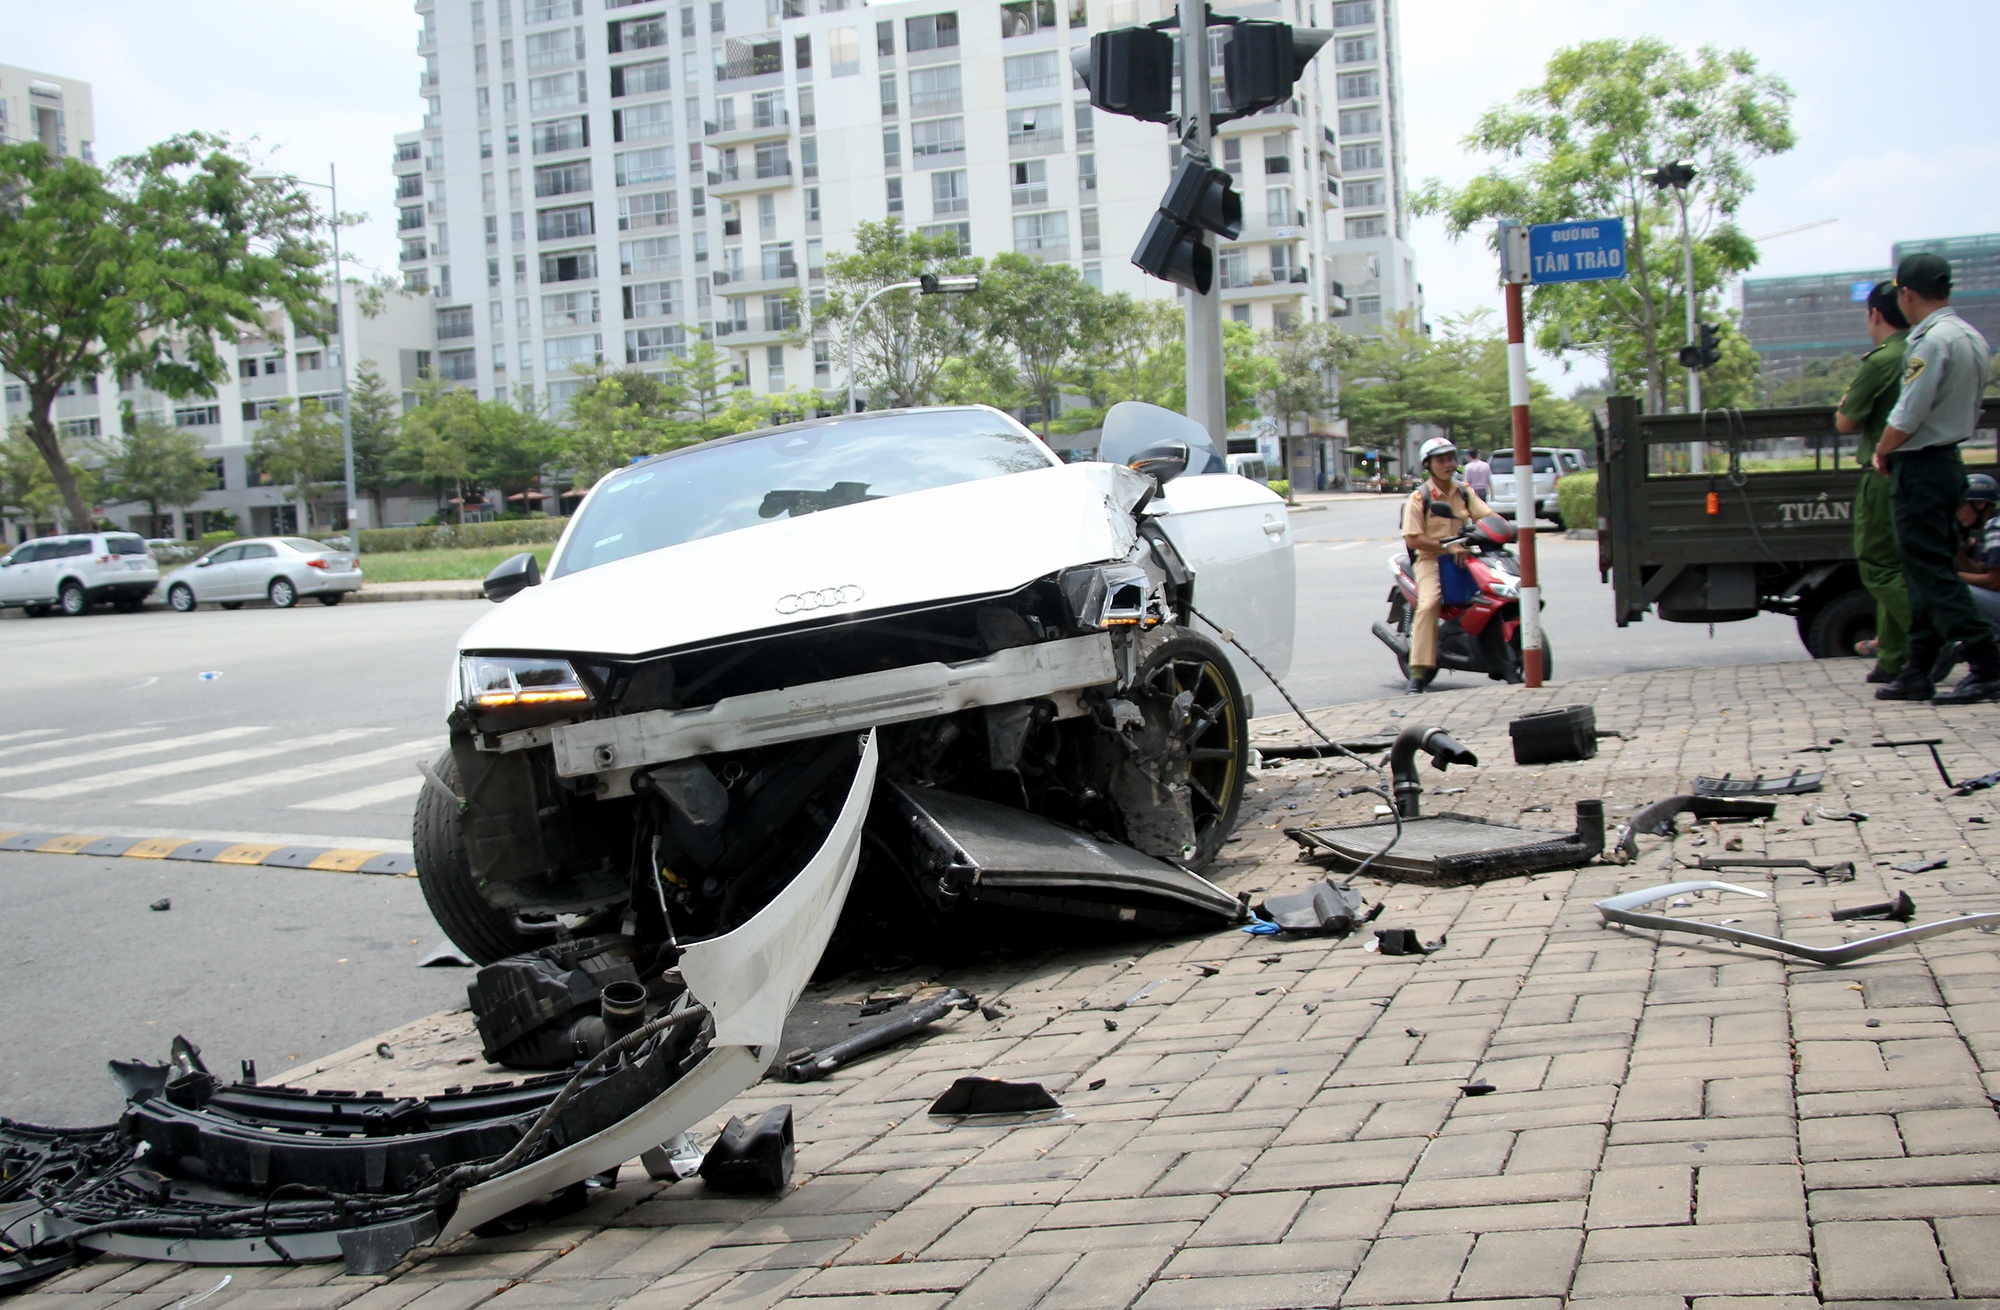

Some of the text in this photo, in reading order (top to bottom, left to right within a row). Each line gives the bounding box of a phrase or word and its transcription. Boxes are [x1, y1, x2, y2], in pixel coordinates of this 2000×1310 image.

[1553, 226, 1599, 241] ĐƯỜNG
[1535, 247, 1620, 273] TÂN TRÀO
